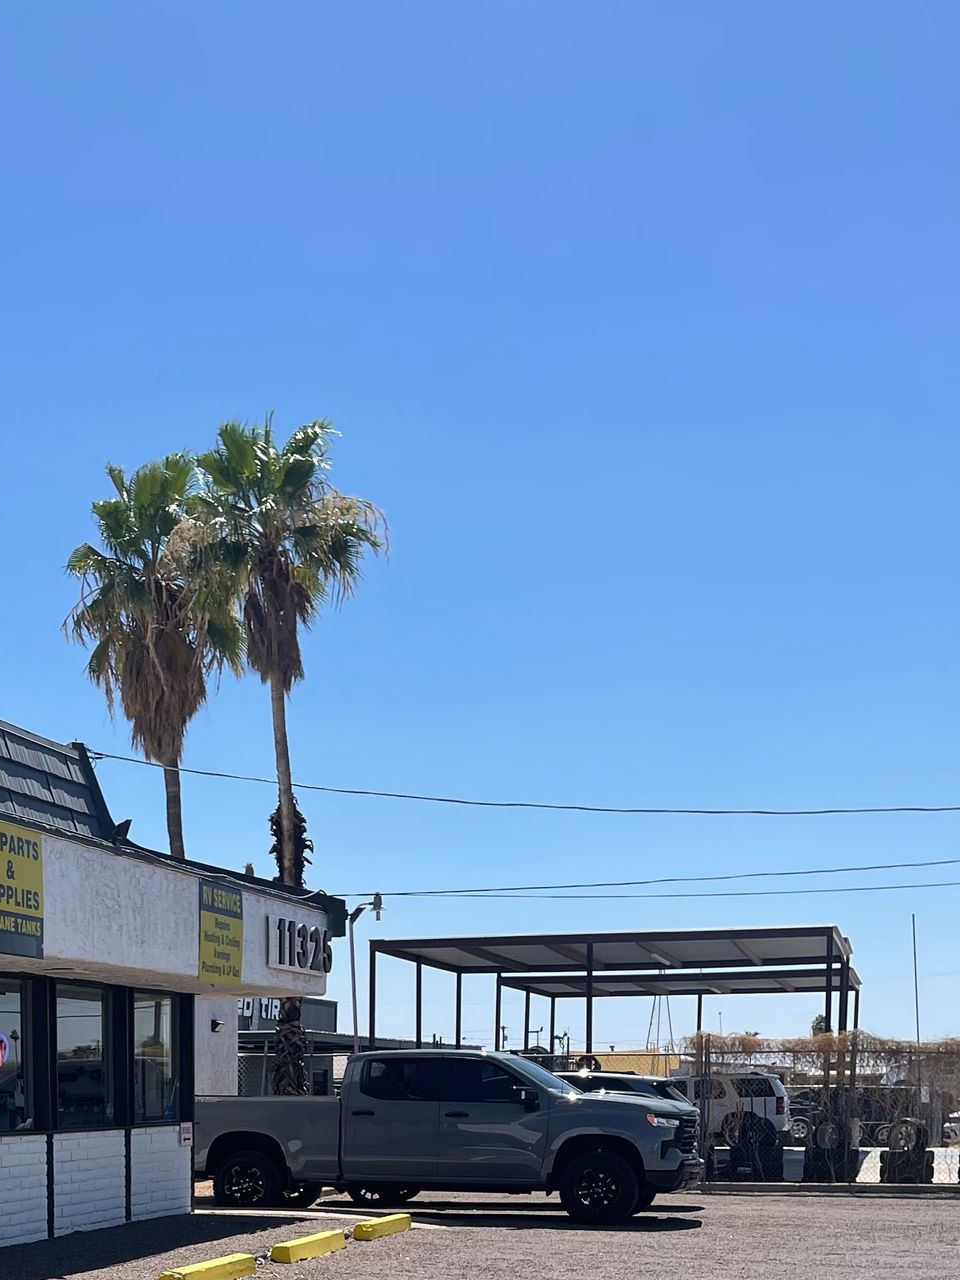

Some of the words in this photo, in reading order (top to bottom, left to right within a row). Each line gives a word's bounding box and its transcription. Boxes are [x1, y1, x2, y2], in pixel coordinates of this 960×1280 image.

[0, 831, 38, 861] PARTS
[6, 860, 15, 880] &
[203, 885, 212, 906] RV
[214, 888, 241, 913] SERVICE
[17, 919, 41, 936] TANKS
[277, 918, 332, 973] 11325
